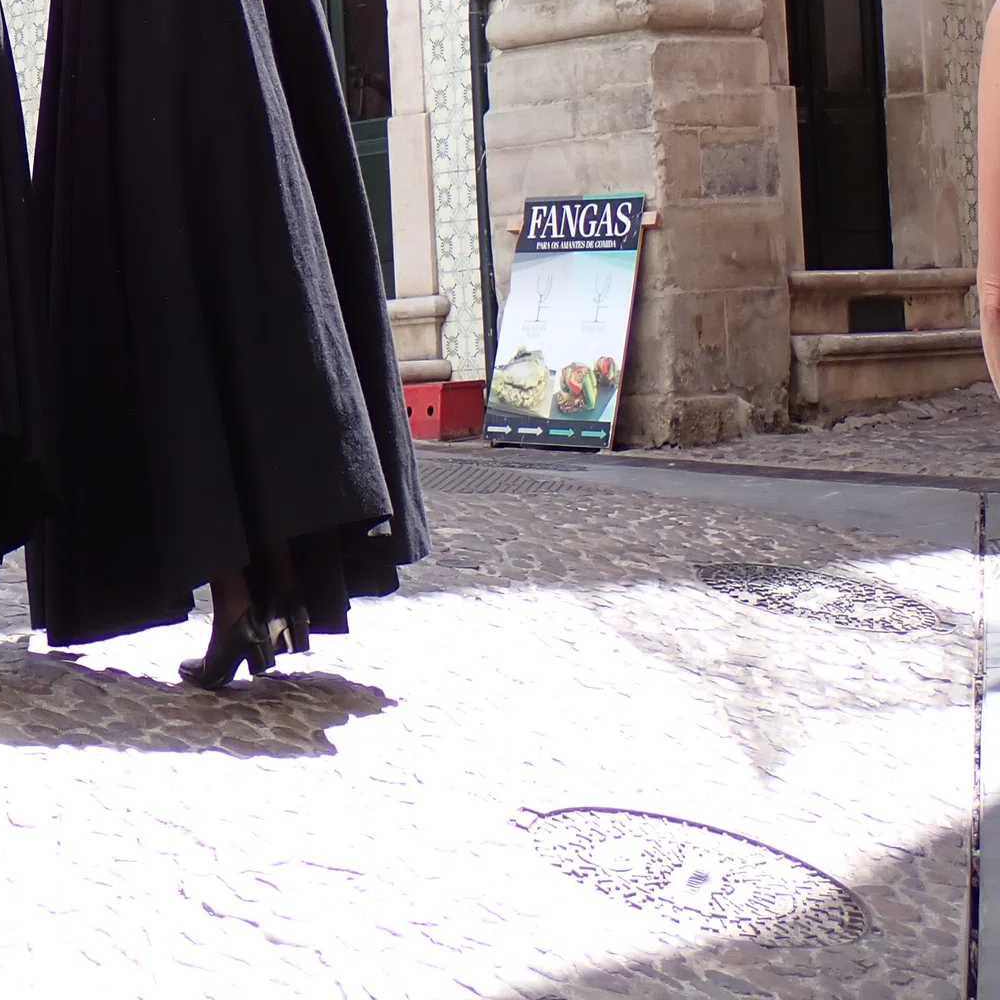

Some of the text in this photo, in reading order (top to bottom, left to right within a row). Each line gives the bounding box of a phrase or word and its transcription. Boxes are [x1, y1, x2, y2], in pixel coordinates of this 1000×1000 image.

[527, 201, 633, 239] FANGAS
[536, 241, 551, 250] PARA
[551, 241, 560, 250] OS
[560, 240, 585, 250] AMANTES
[585, 240, 594, 249] DE
